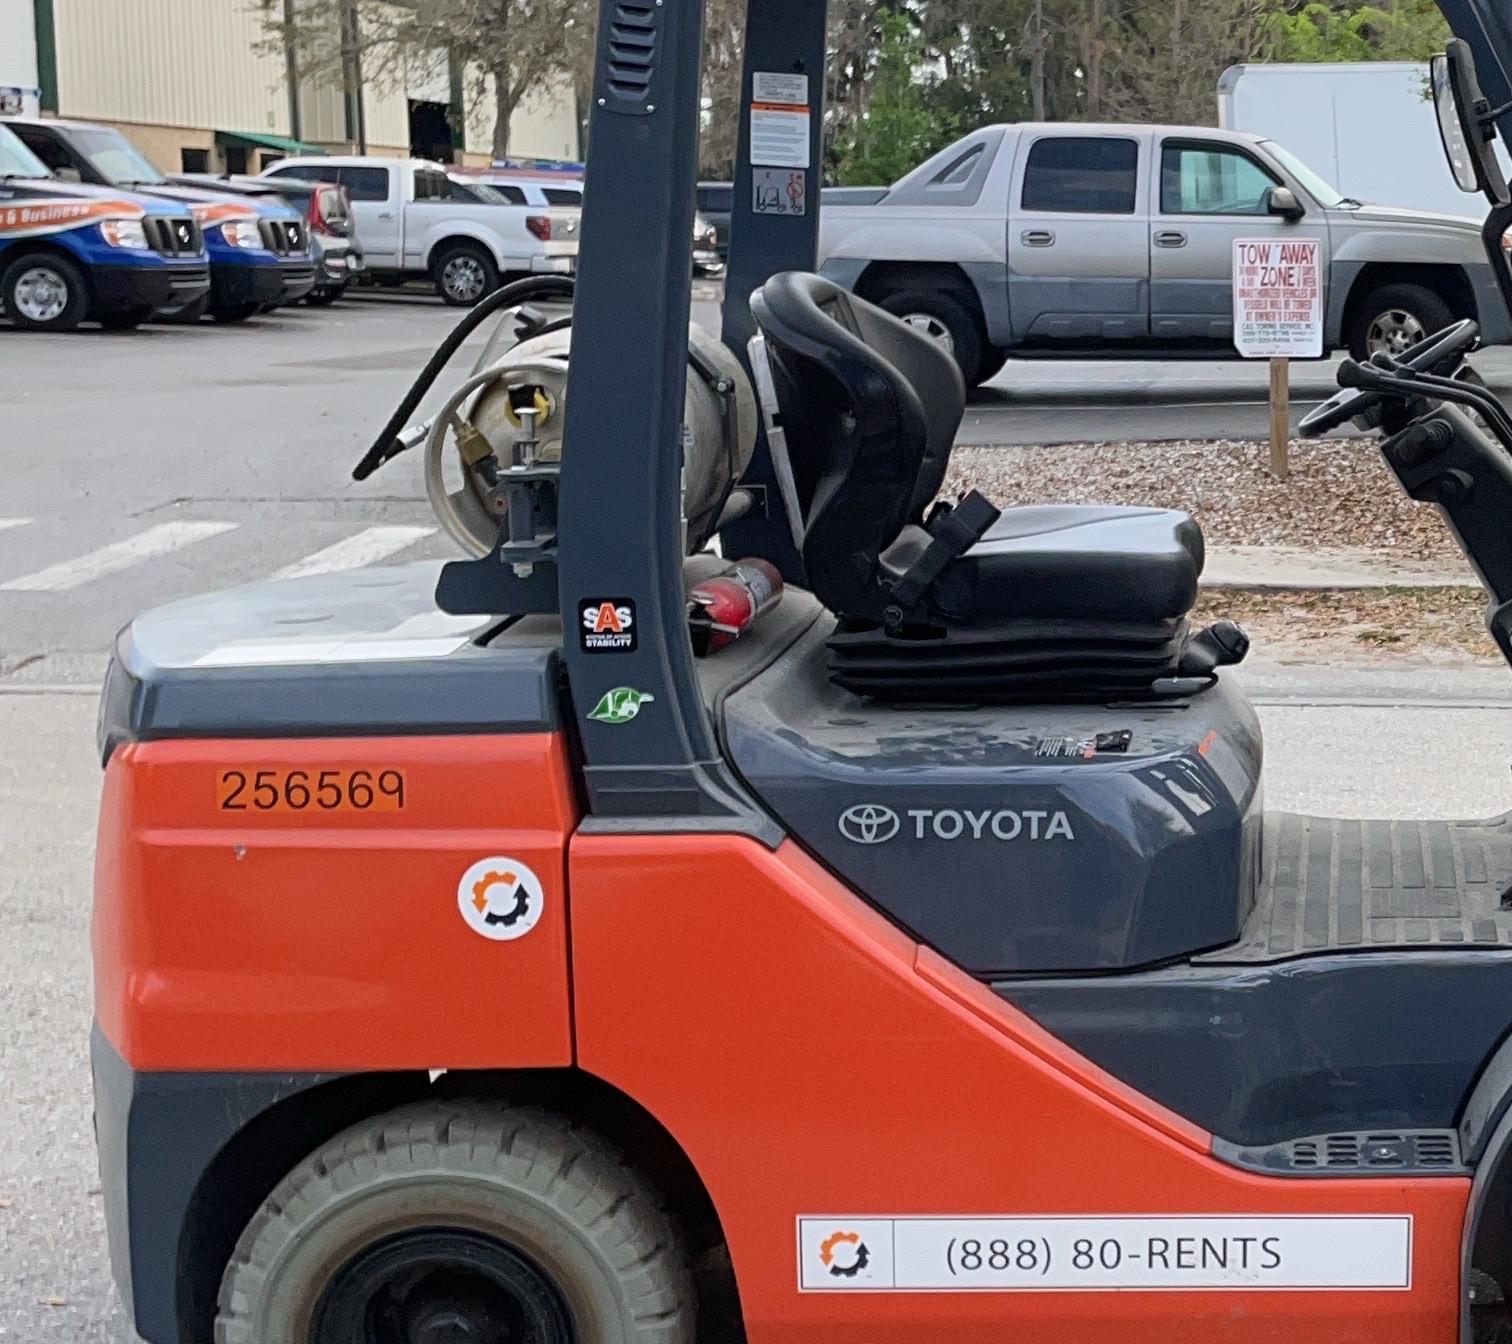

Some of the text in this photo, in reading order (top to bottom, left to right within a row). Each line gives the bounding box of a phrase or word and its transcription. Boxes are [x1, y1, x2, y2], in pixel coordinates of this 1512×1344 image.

[21, 203, 89, 223] Business
[1238, 244, 1316, 265] TOW AWAY
[1260, 266, 1295, 287] ZONE
[583, 602, 632, 633] SAS
[586, 639, 632, 647] STABILITY
[220, 769, 405, 811] 256569
[907, 809, 1075, 840] TOYOTA
[946, 1236, 1282, 1276] (888) 80-RENTS
